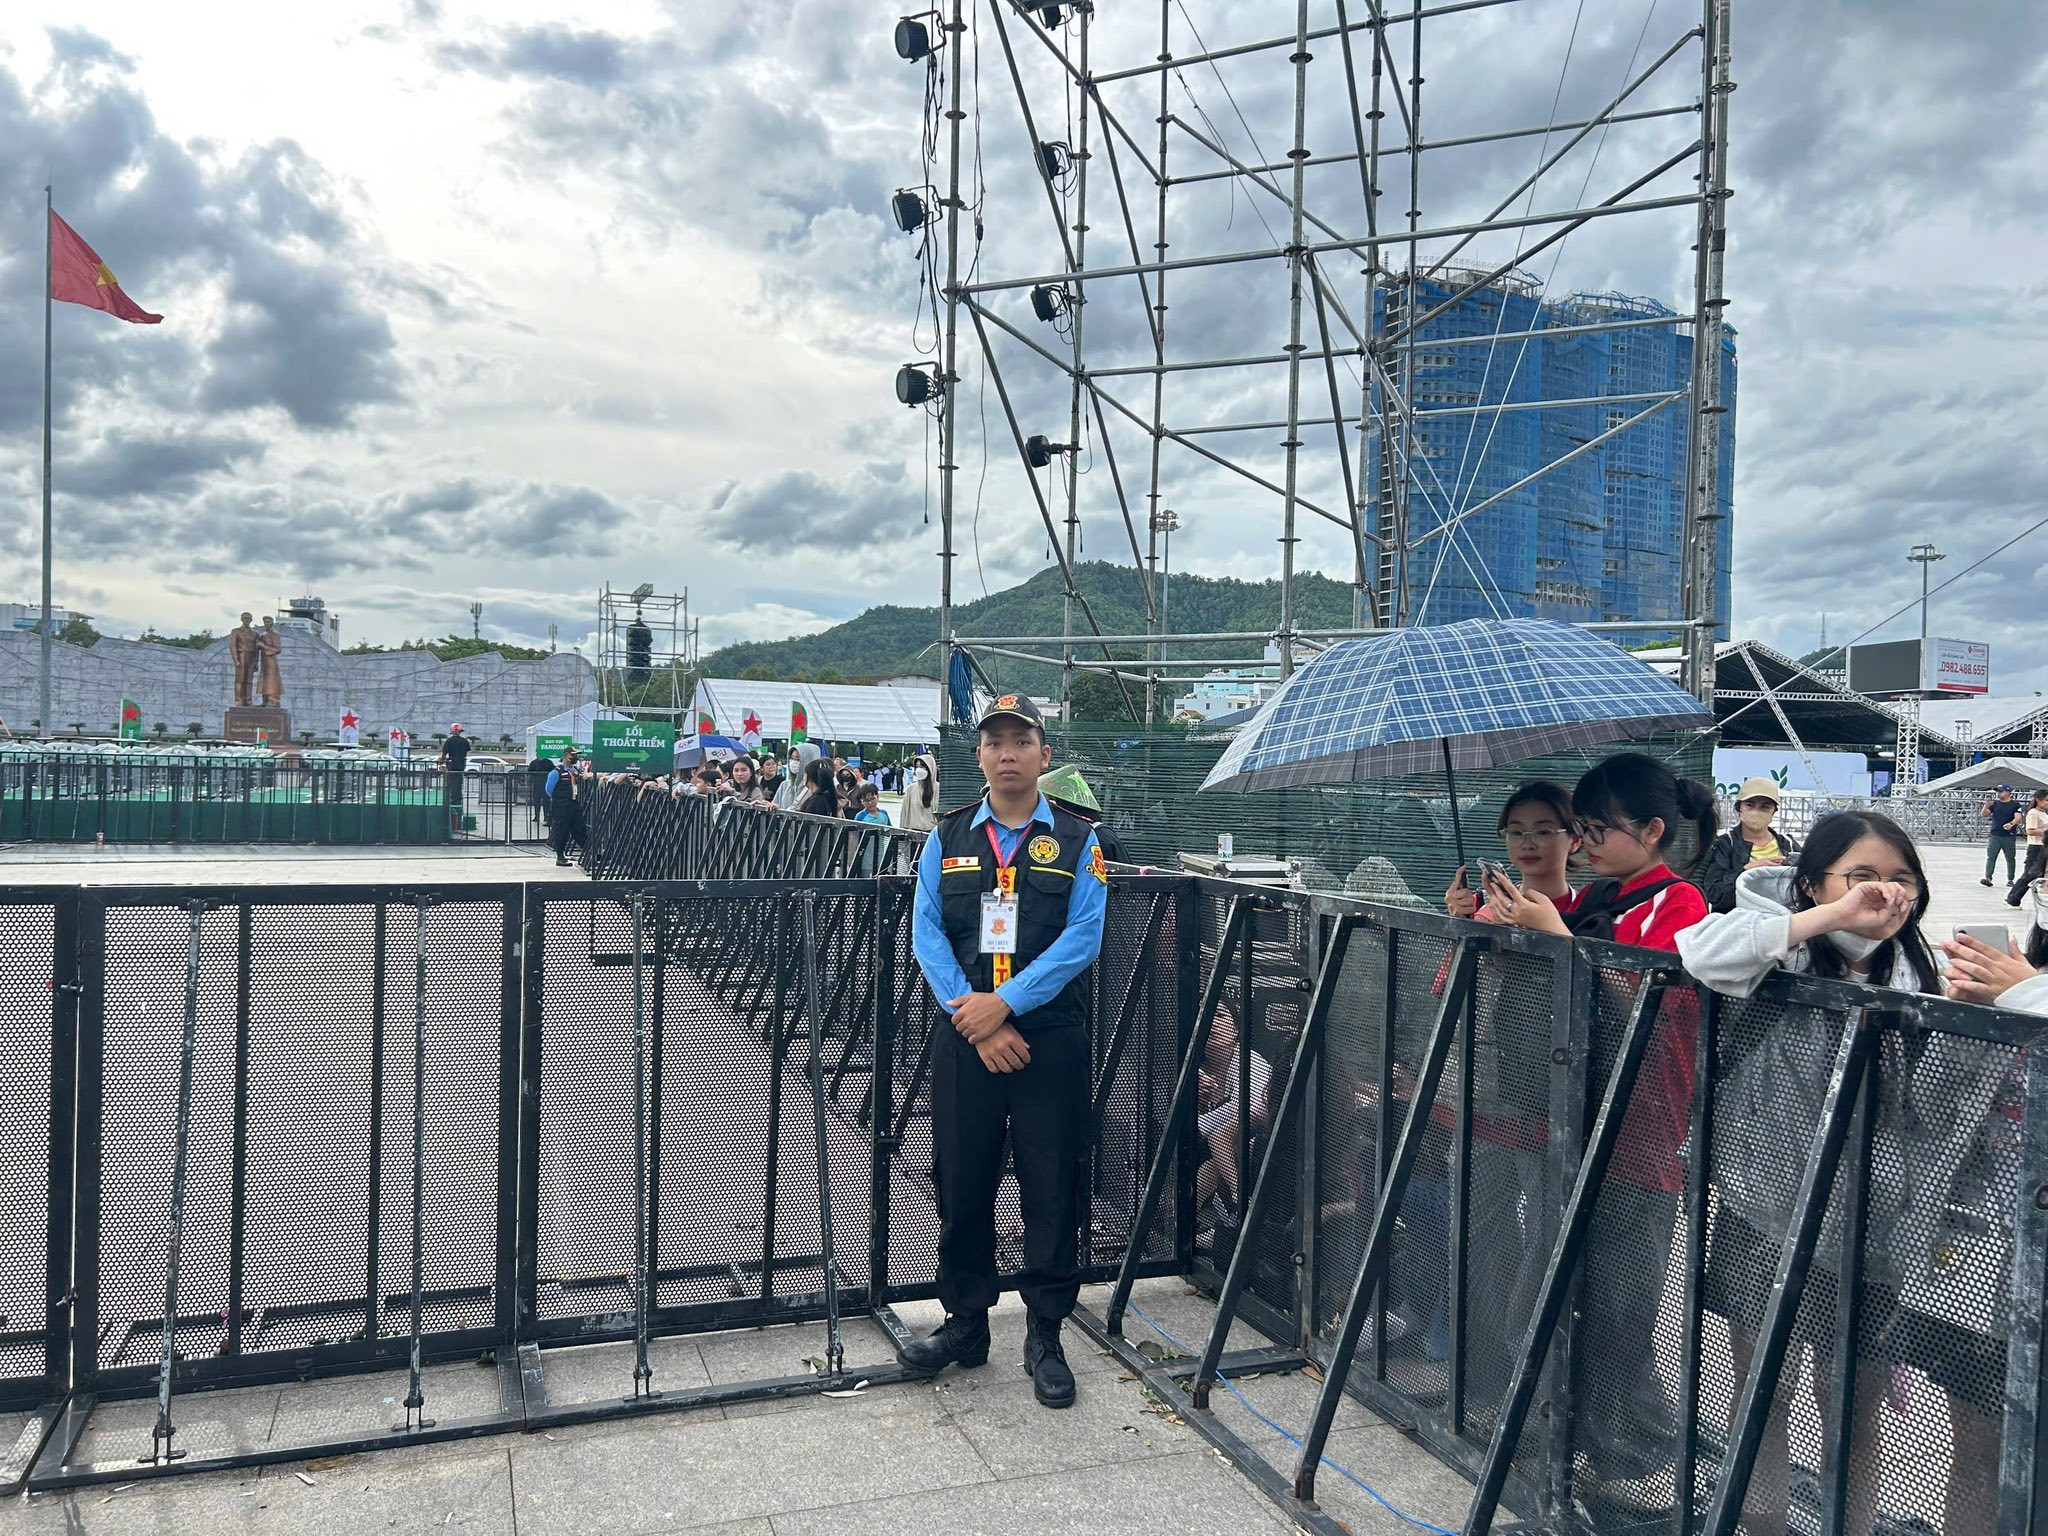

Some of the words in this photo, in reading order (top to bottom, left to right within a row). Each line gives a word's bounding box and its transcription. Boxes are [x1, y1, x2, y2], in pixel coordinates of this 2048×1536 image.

[626, 725, 643, 736] LỐI
[602, 737, 637, 747] THOÁT
[639, 735, 665, 748] HIỂM
